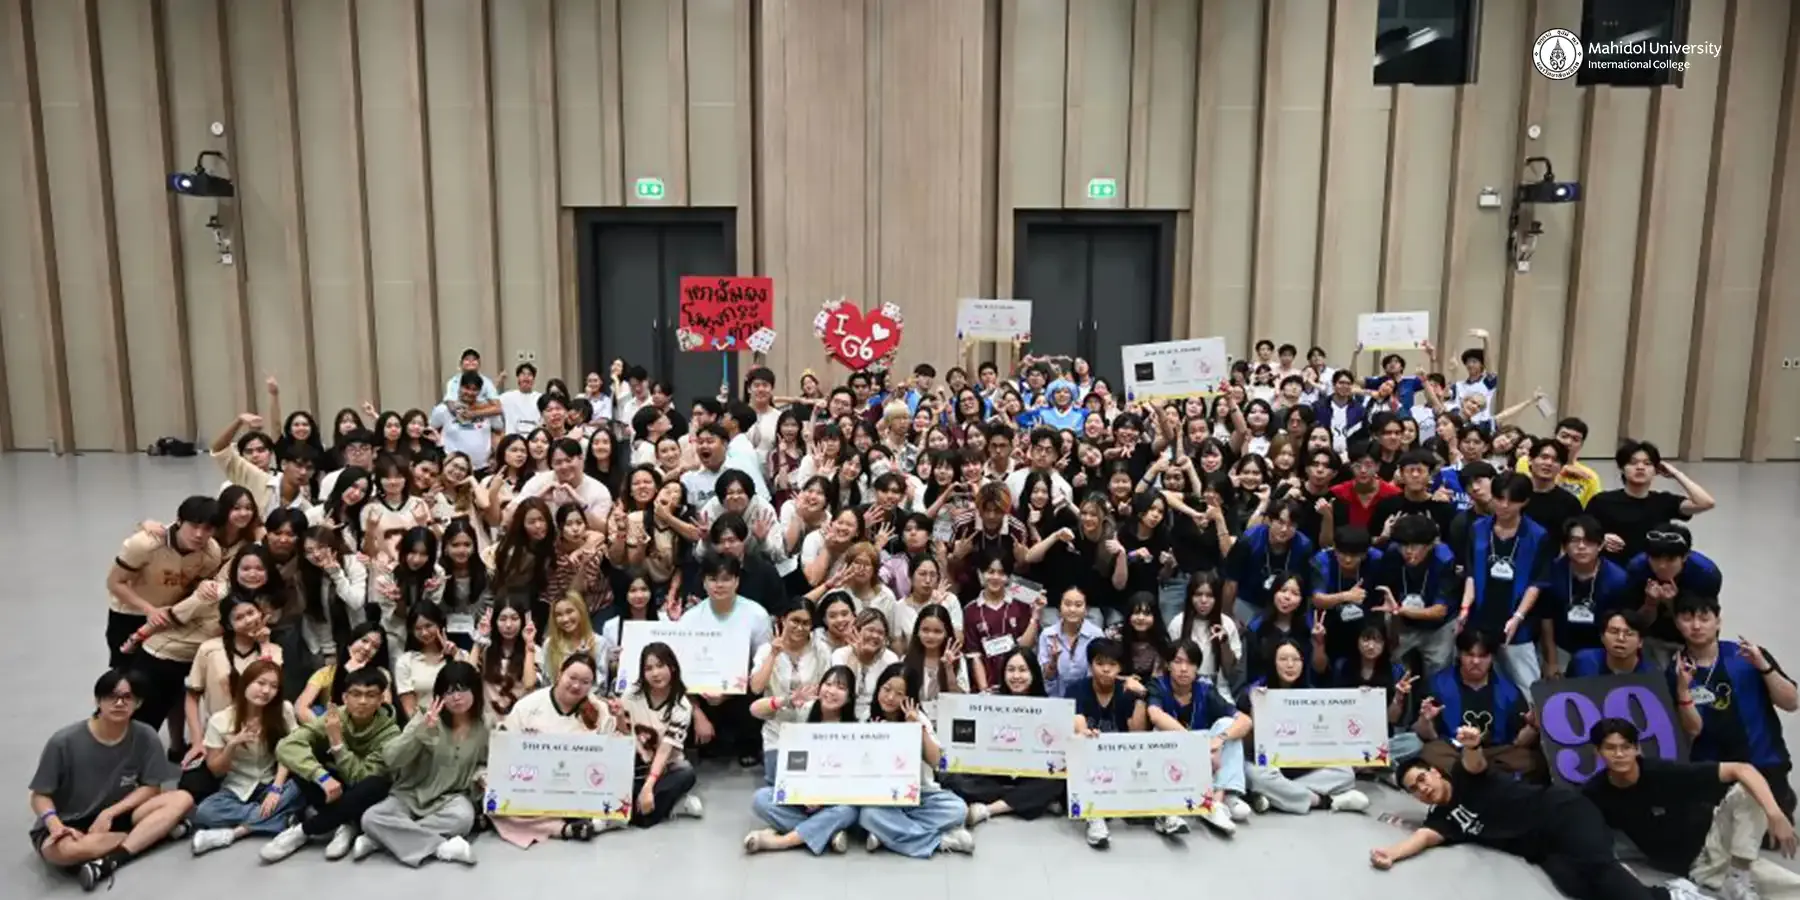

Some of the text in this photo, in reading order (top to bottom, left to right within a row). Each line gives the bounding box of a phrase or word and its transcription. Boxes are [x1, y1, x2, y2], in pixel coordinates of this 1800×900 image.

[833, 313, 849, 336] I
[840, 334, 874, 360] G6
[984, 705, 1010, 713] PLACE
[1012, 707, 1042, 715] AWARD
[1541, 685, 1677, 784] 99
[1117, 743, 1144, 751] PLACE
